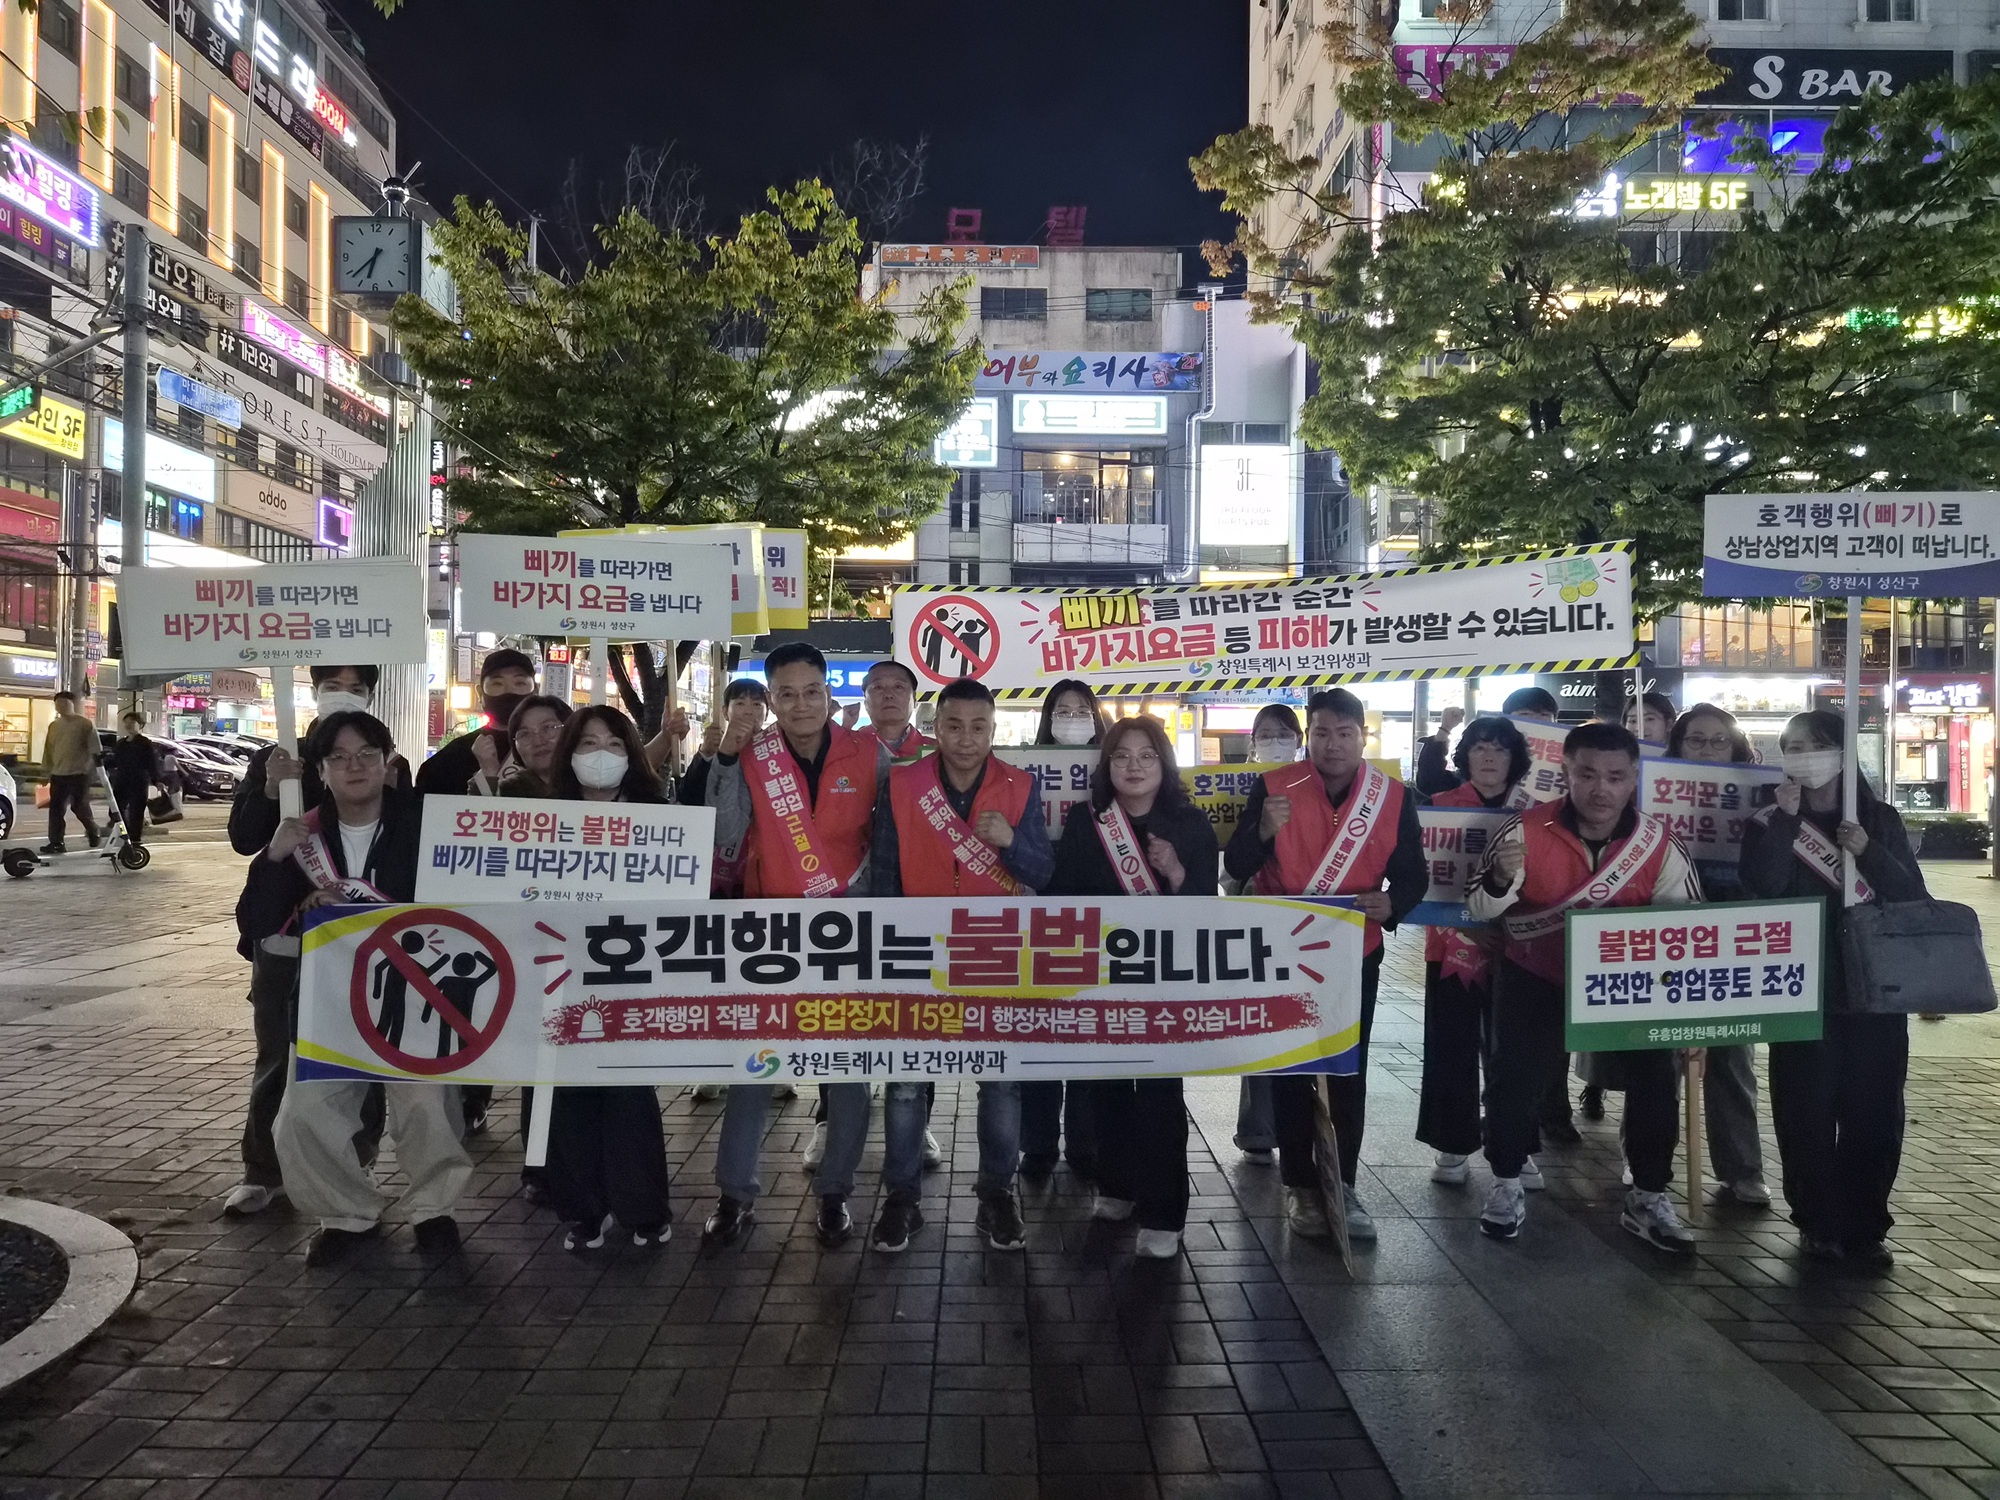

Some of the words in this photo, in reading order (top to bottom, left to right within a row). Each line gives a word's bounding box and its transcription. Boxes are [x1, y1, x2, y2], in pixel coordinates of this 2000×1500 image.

[1749, 54, 1786, 100] S
[1799, 69, 1893, 98] BAR
[1624, 181, 1704, 210] 노래방
[1709, 181, 1748, 211] 5F
[19, 218, 42, 246] 힐링
[370, 223, 382, 233] 12
[342, 252, 349, 262] 9
[402, 253, 410, 263] 3
[207, 286, 224, 307] Bar
[371, 282, 379, 292] 6
[239, 338, 278, 378] 가라오케
[982, 354, 1058, 388] 어부와
[1061, 355, 1151, 389] 요리사
[63, 414, 82, 438] 3F
[258, 489, 288, 511] addo
[1724, 534, 1840, 560] 상남상업지역
[1845, 534, 1905, 559] 고객이
[1912, 534, 1996, 560] 떠납니다.
[522, 549, 597, 580] 삐끼를
[599, 558, 673, 582] 따라가면
[195, 578, 276, 608] 삐끼를
[279, 584, 360, 608] 따라가면
[492, 580, 572, 611] 바가지
[576, 583, 648, 613] 요금을
[648, 591, 703, 615] 냅니다
[1827, 576, 1872, 591] 창원시
[1876, 575, 1921, 591] 성산구
[1189, 592, 1283, 618] 따라간
[1292, 586, 1354, 611] 순간
[163, 612, 252, 642] 바가지
[257, 612, 334, 640] 요금을
[335, 616, 393, 639] 냅니다
[579, 619, 607, 632] 창원시
[608, 619, 637, 632] 성산구
[1040, 622, 1217, 673] 바가지요금
[1223, 625, 1252, 654] 등
[1257, 614, 1358, 651] 피해가
[1364, 610, 1453, 646] 발생할
[1457, 611, 1487, 639] 수
[1492, 602, 1615, 638] 있습니다.
[261, 648, 292, 661] 창원시
[293, 648, 323, 661] 성산구
[1216, 655, 1292, 676] 창원특례시
[1296, 651, 1373, 672] 보건위생과
[1652, 777, 1741, 810] 호객꾼을
[452, 808, 576, 846] 호객행위는
[580, 814, 686, 849] 불법입니다
[431, 845, 510, 877] 삐끼를
[515, 846, 617, 883] 따라가지
[622, 854, 700, 886] 맙시다
[542, 888, 573, 901] 창원시
[581, 909, 936, 987] 호객행위는
[943, 906, 1291, 988] 불법입니다.
[1595, 924, 1721, 964] 불법영업
[1732, 920, 1794, 956] 근절
[1584, 971, 1655, 1007] 건전한
[1660, 966, 1754, 1003] 영업풍토
[1760, 962, 1807, 1000] 조성
[620, 1005, 710, 1034] 호객행위
[714, 1003, 760, 1032] 적발
[764, 1004, 788, 1031] 시
[795, 999, 901, 1034] 영업정지
[908, 1001, 985, 1034] 15일의
[990, 1003, 1098, 1035] 행정처분을
[1103, 1005, 1149, 1035] 받을
[1152, 1005, 1177, 1033] 수
[1181, 1004, 1275, 1034] 있습니다.
[785, 1049, 895, 1076] 창원특례시
[900, 1048, 1009, 1076] 보건위생과
